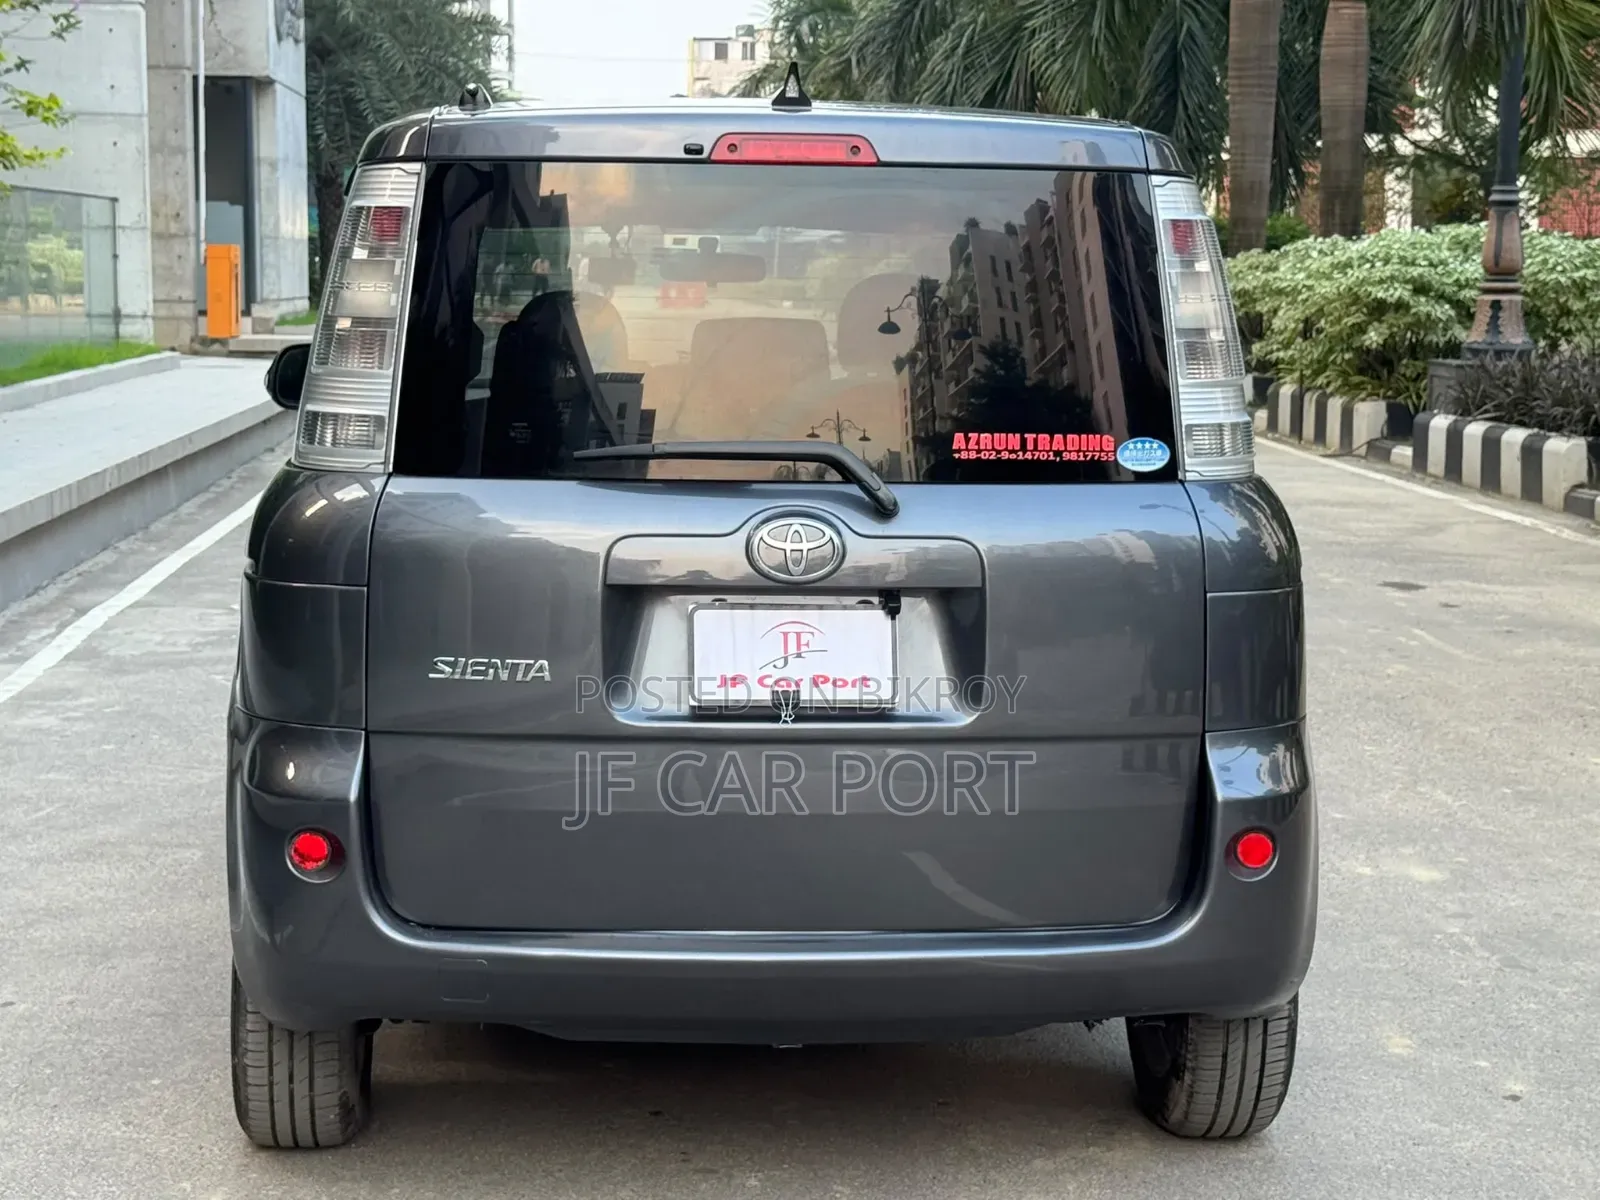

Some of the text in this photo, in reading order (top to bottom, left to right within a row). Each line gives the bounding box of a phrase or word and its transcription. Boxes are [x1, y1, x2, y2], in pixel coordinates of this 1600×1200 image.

[952, 432, 1115, 451] AZRUN TRADING
[1062, 451, 1116, 461] 9817755
[772, 631, 815, 670] JF
[428, 656, 552, 682] SIENTA
[757, 674, 804, 689] Car
[812, 674, 871, 689] Port
